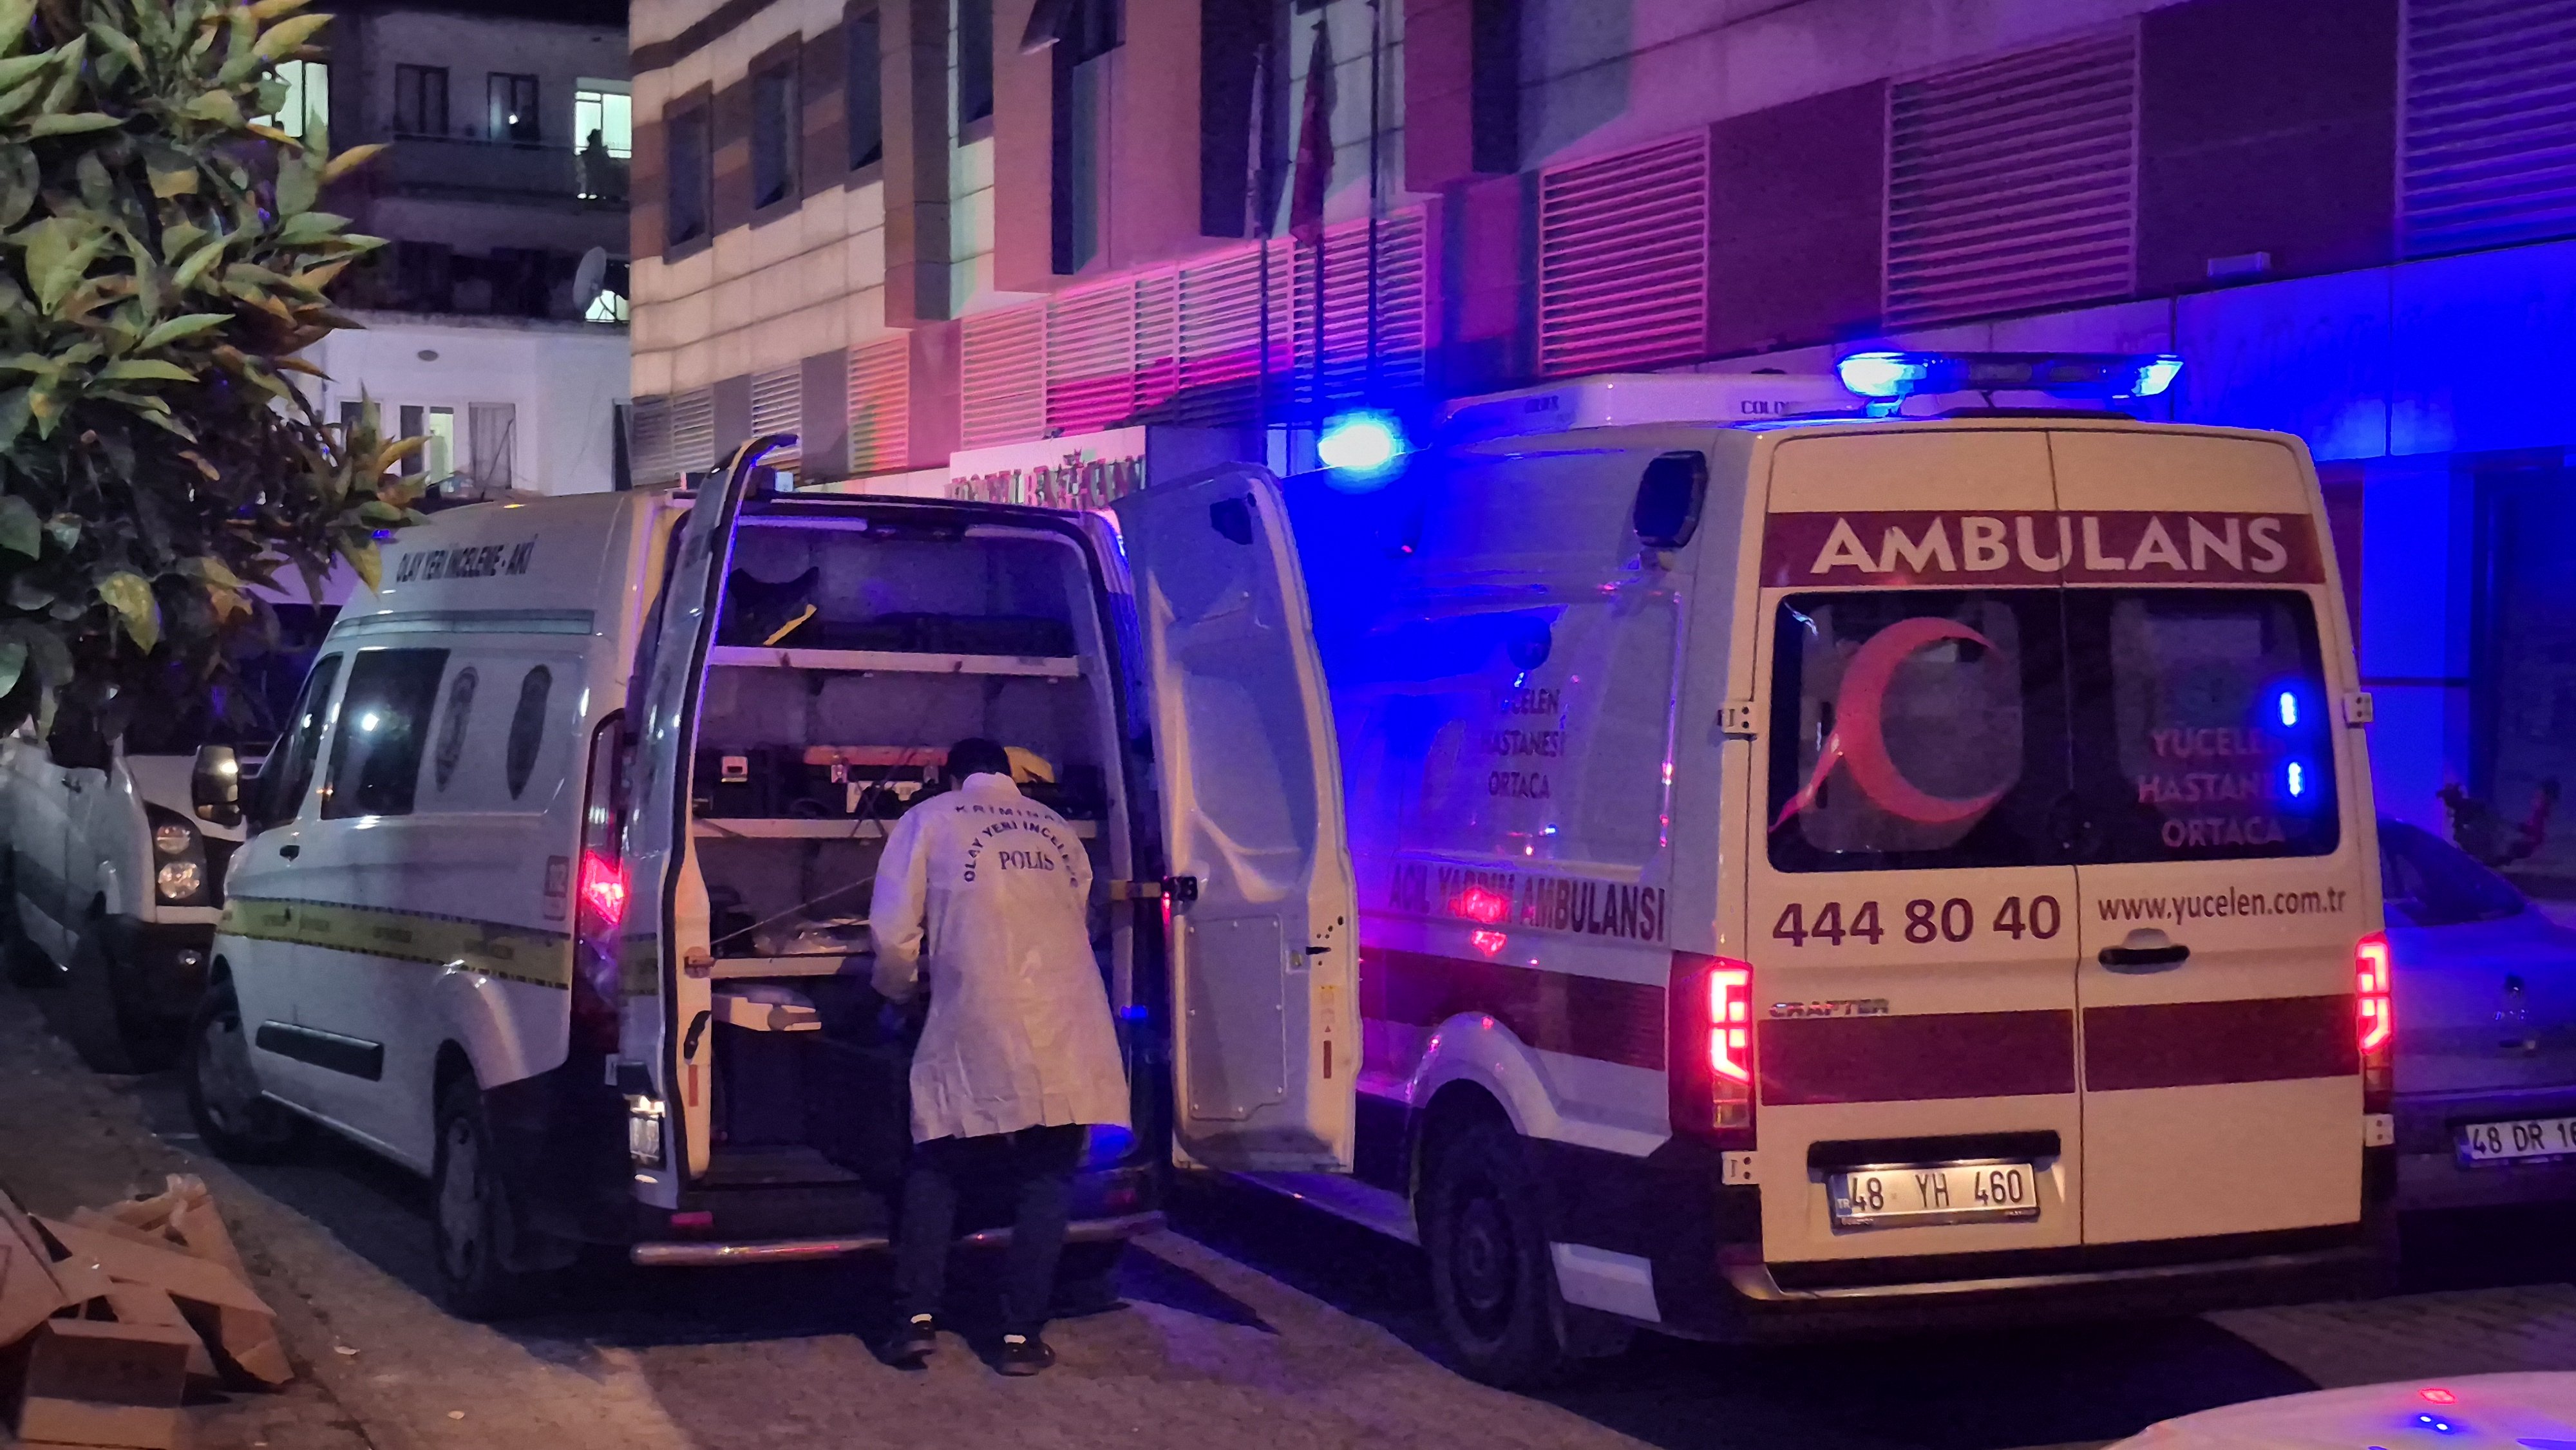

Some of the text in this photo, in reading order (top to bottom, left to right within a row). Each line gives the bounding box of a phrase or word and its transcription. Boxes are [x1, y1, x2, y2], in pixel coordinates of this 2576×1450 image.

[1810, 516, 2287, 573] AMBULANS
[2161, 816, 2287, 848] ORTACA
[964, 837, 983, 882] OLAY
[1772, 895, 2061, 946] 444 80 40
[2098, 885, 2347, 925] www.yucelen.com.tr
[1768, 998, 1889, 1017] CRAFTER
[2472, 1125, 2503, 1154] 48
[2512, 1123, 2546, 1152] DR
[1852, 1169, 2025, 1211] 48 YH 460
